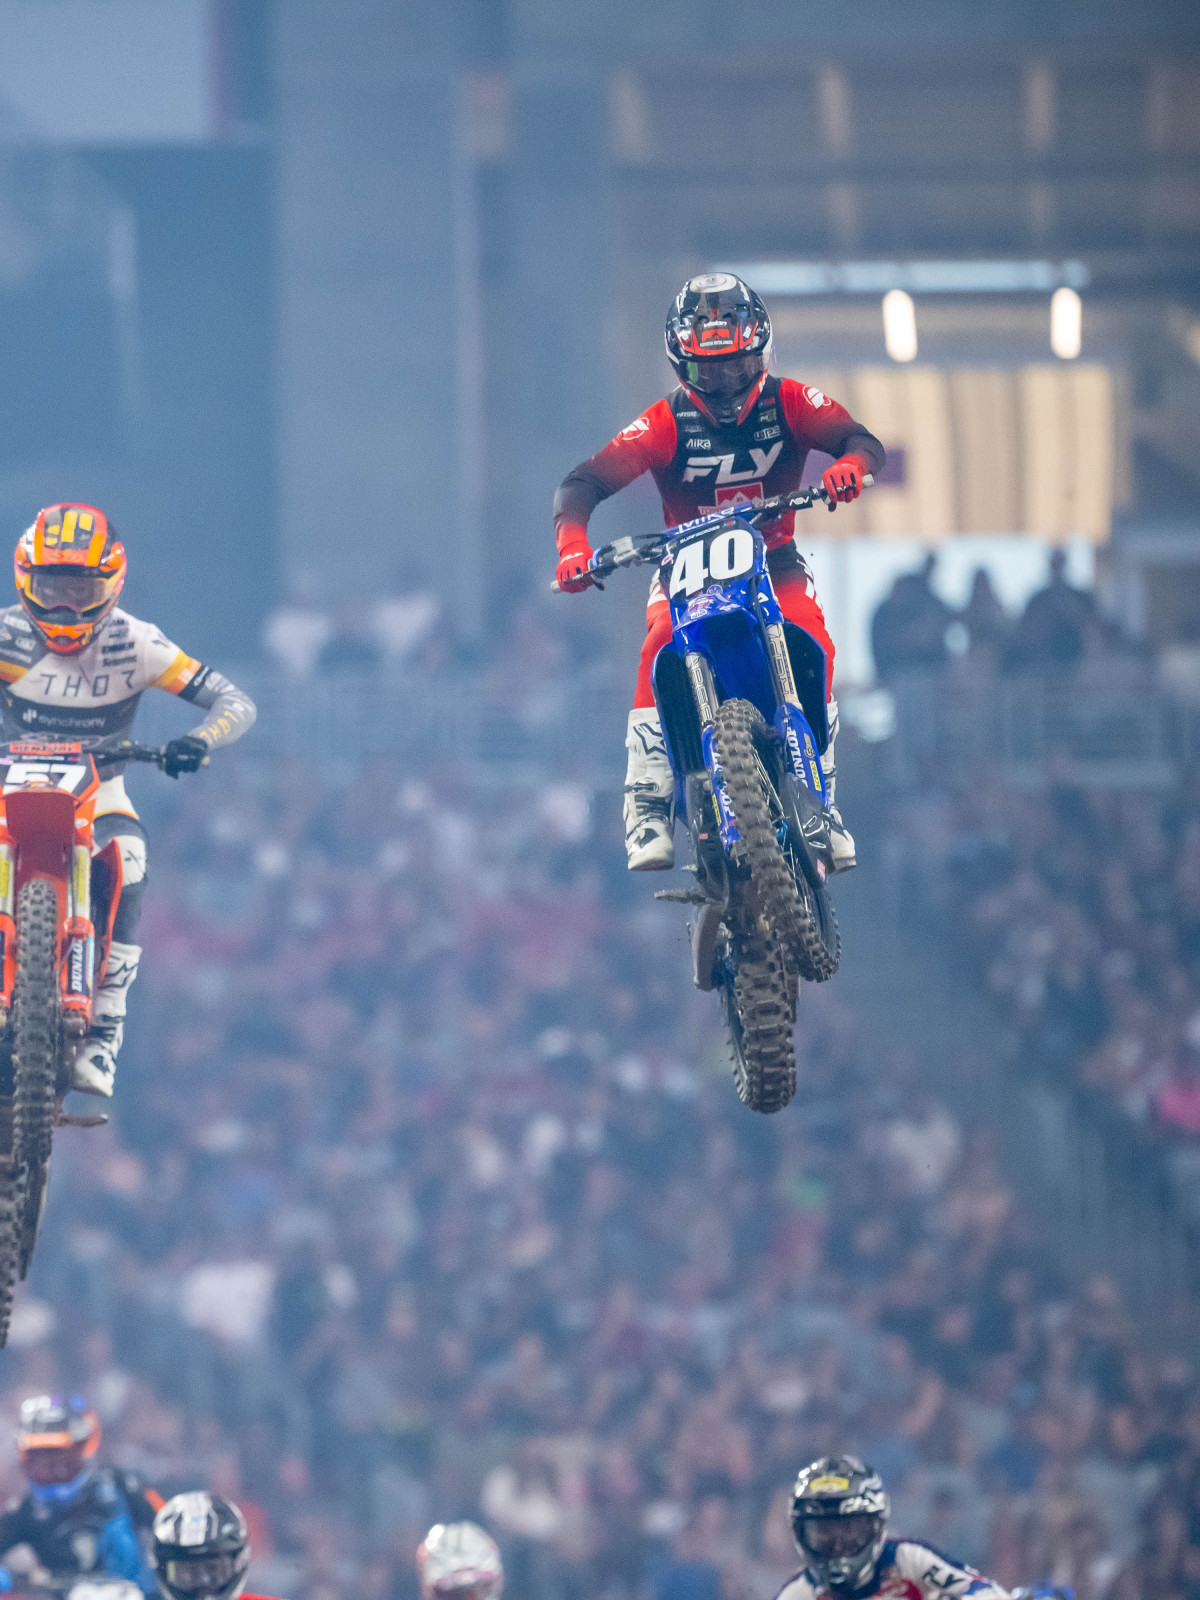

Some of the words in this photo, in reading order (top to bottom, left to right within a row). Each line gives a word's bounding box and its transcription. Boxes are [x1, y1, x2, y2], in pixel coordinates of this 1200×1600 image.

[681, 440, 784, 485] FLY
[668, 529, 754, 600] 40
[2, 763, 87, 796] 57
[71, 937, 84, 993] DUNLO
